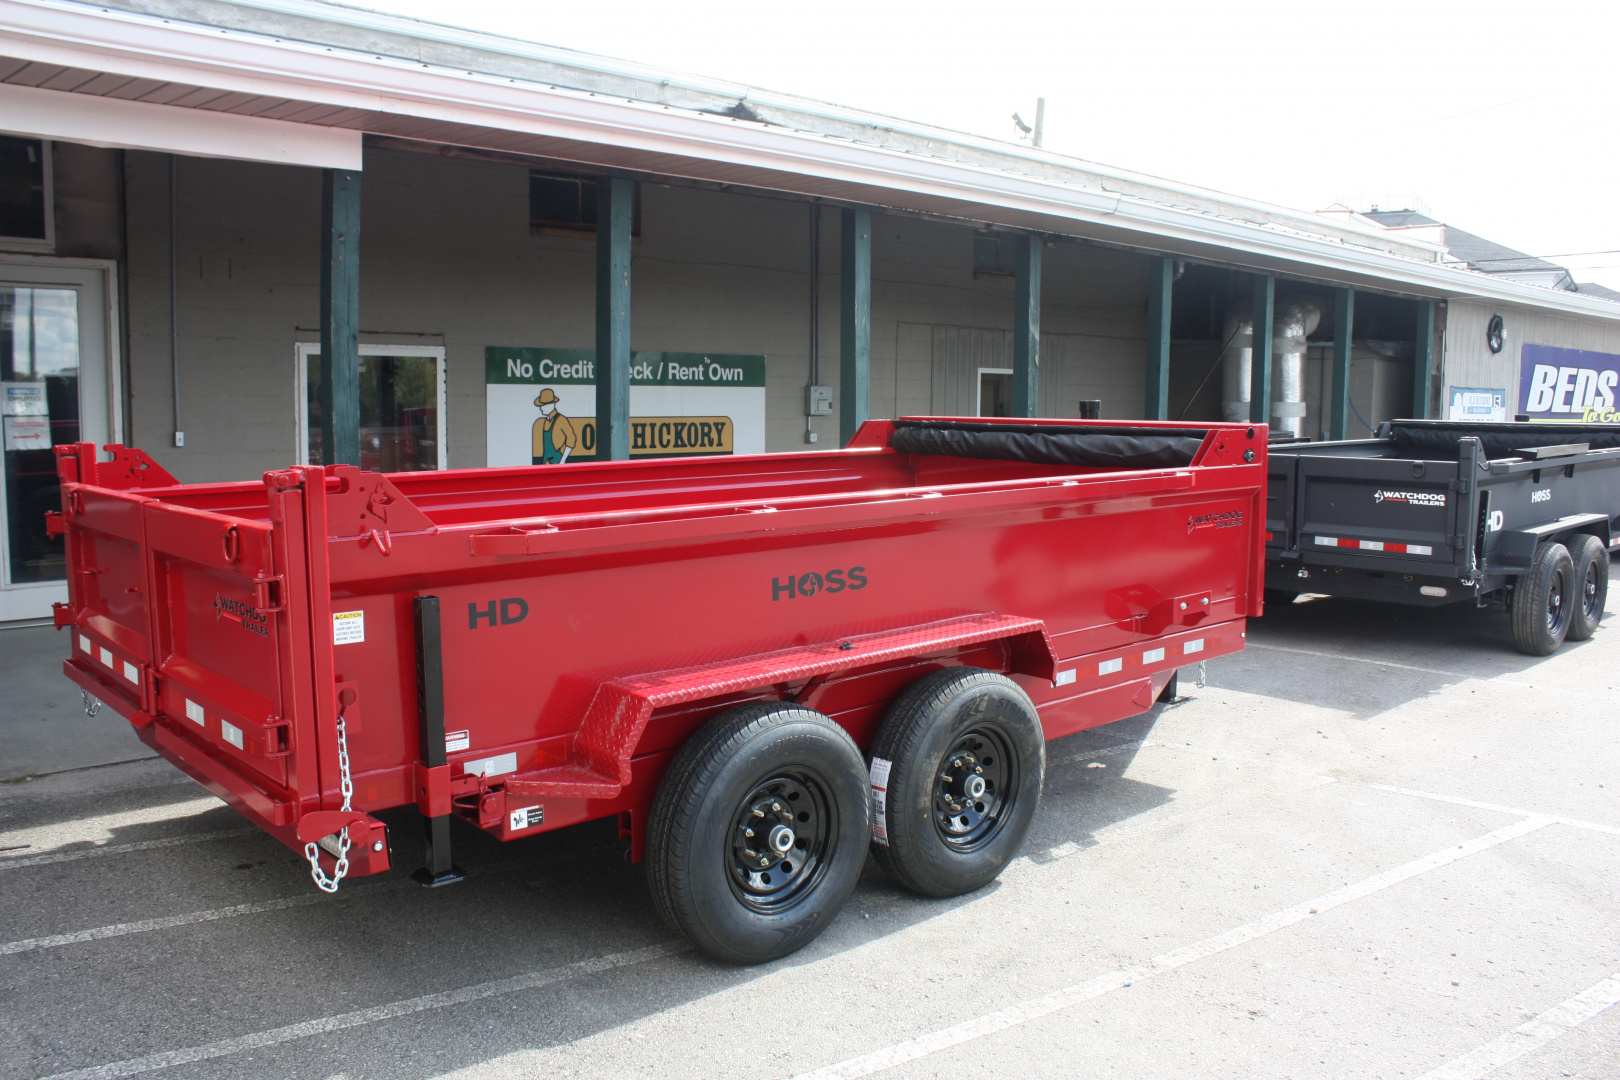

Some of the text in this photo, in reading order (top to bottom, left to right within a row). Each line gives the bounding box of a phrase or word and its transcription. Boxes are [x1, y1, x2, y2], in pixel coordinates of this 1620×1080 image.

[506, 358, 533, 378] No
[539, 359, 594, 379] Credit
[657, 362, 663, 380] /
[668, 362, 704, 380] Rent
[704, 356, 711, 364] To
[708, 363, 744, 381] Own
[1525, 363, 1619, 414] BEDS
[1581, 406, 1620, 423] To Go
[631, 421, 726, 449] HICKORY
[1383, 490, 1446, 501] WATCHDOG
[1408, 499, 1445, 507] TRAILERS
[1531, 488, 1551, 503] HOSS
[1195, 510, 1243, 524] WATCHDOG
[771, 566, 868, 601] HOSS
[467, 597, 529, 630] HD
